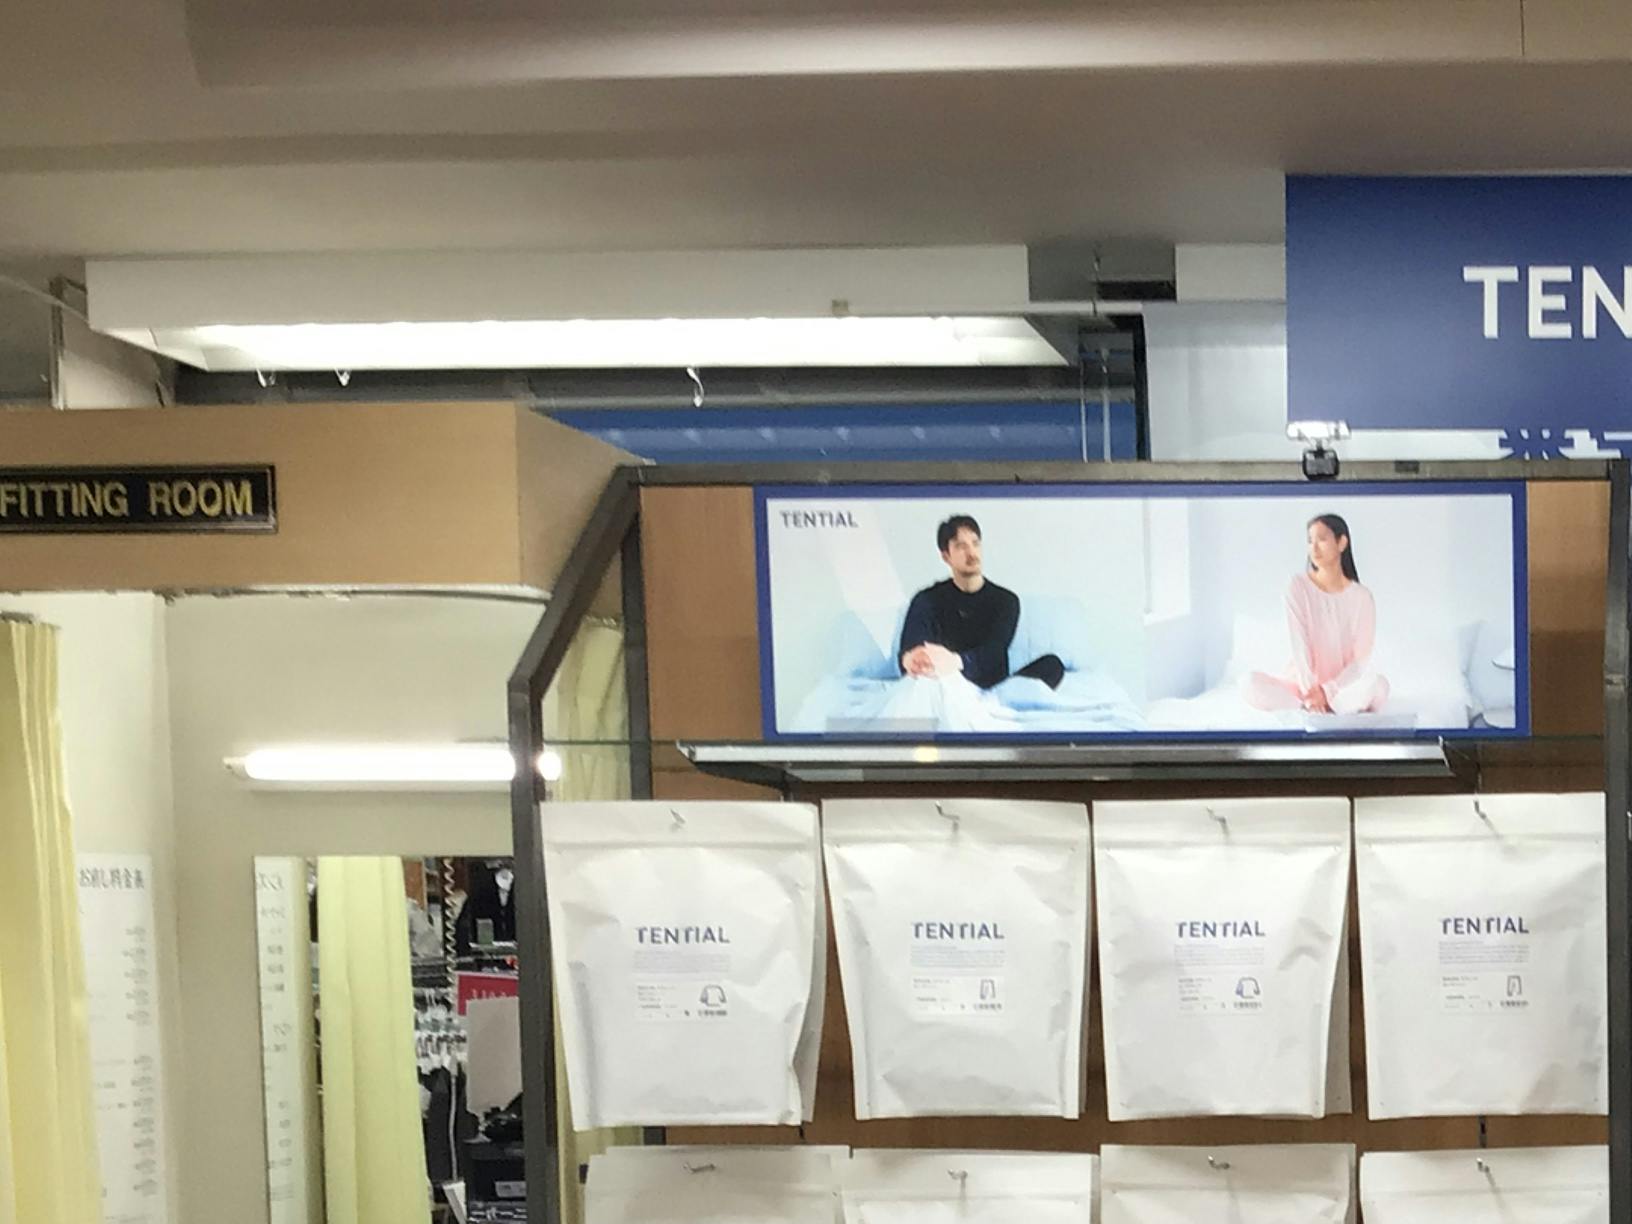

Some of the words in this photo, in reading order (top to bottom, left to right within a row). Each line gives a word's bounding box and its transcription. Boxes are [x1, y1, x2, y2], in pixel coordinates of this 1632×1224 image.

[0, 480, 130, 518] FITTING
[148, 478, 254, 518] ROOM
[780, 510, 858, 529] TENTIAL
[913, 922, 1005, 940] TENTIAL
[1177, 920, 1266, 939] TENTIAL
[1442, 916, 1531, 935] TENTIAL
[637, 926, 730, 945] TENTIAL
